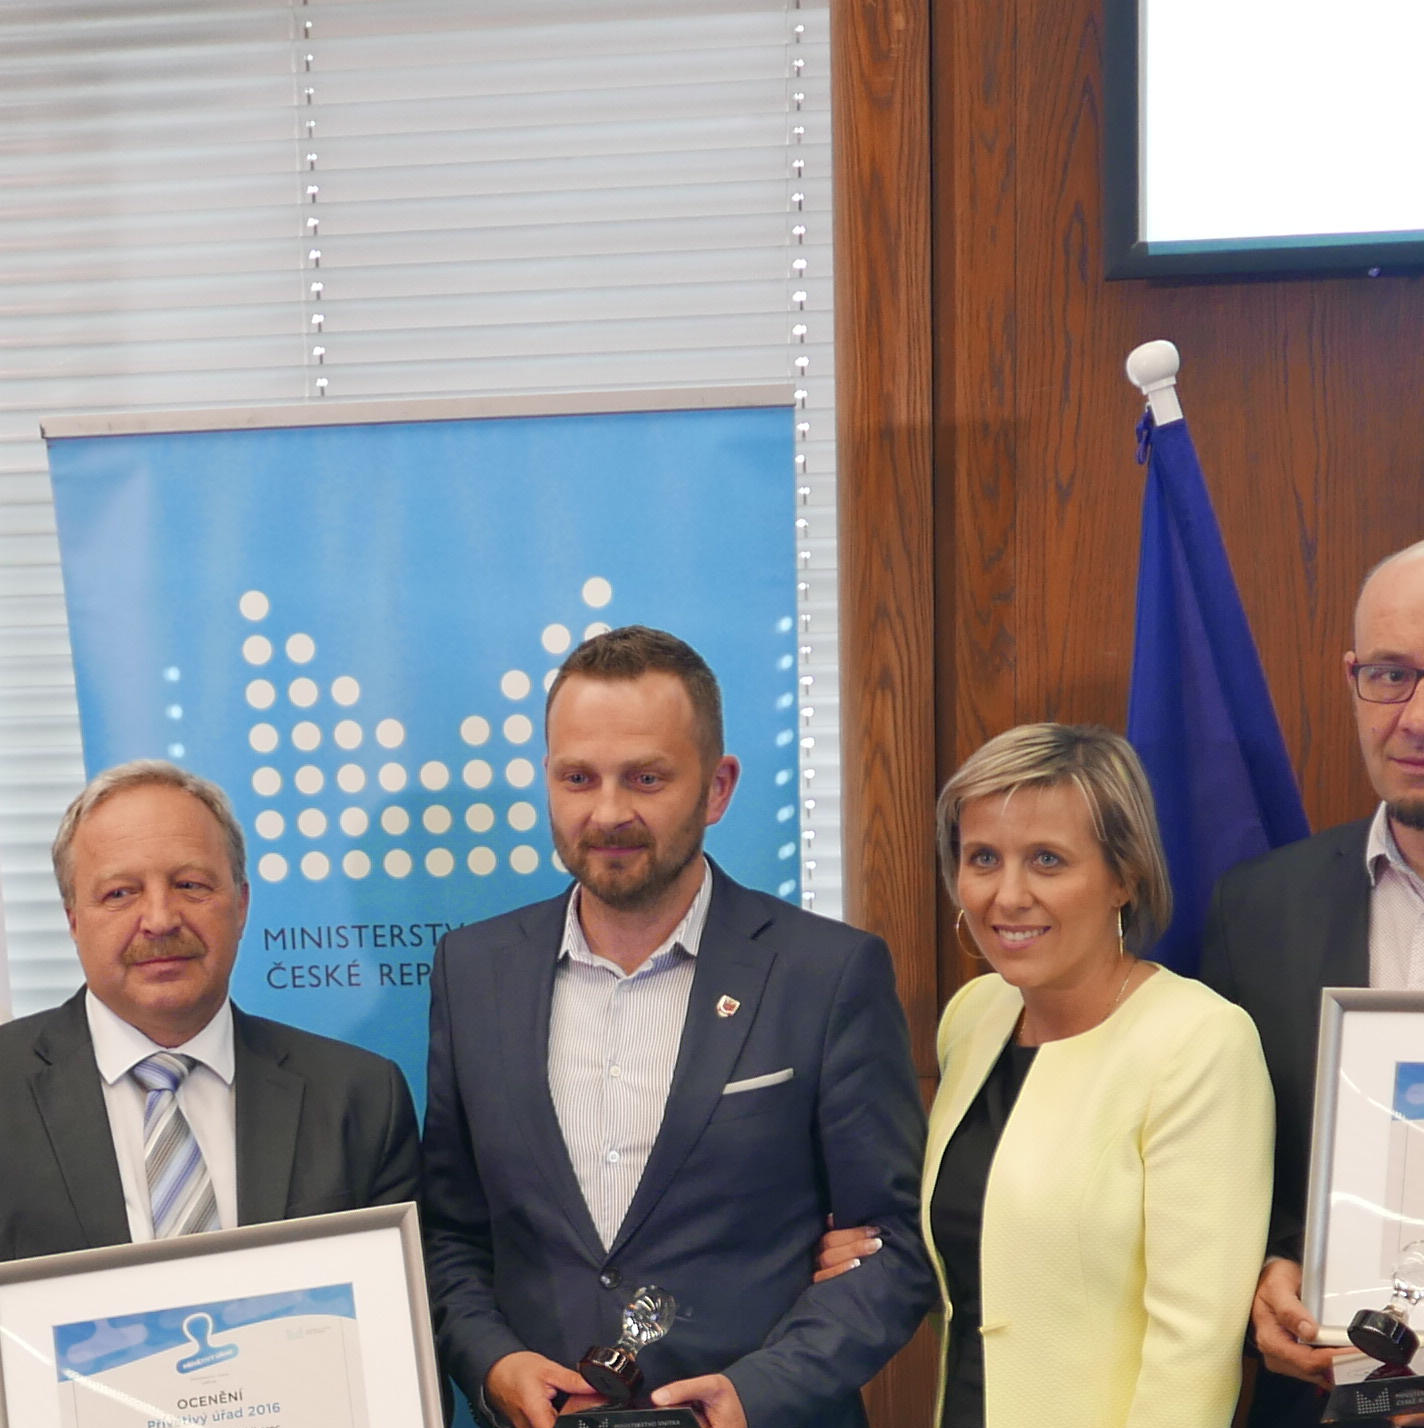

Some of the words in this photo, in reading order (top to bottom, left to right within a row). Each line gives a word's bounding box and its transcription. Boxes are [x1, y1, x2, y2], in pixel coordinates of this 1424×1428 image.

[264, 923, 464, 951] MINISTERST
[266, 959, 361, 989] ČESKÉ
[379, 962, 431, 986] REP
[177, 1388, 244, 1410] OCENĚNÍ
[212, 1407, 244, 1423] úřad
[248, 1402, 281, 1417] 2016
